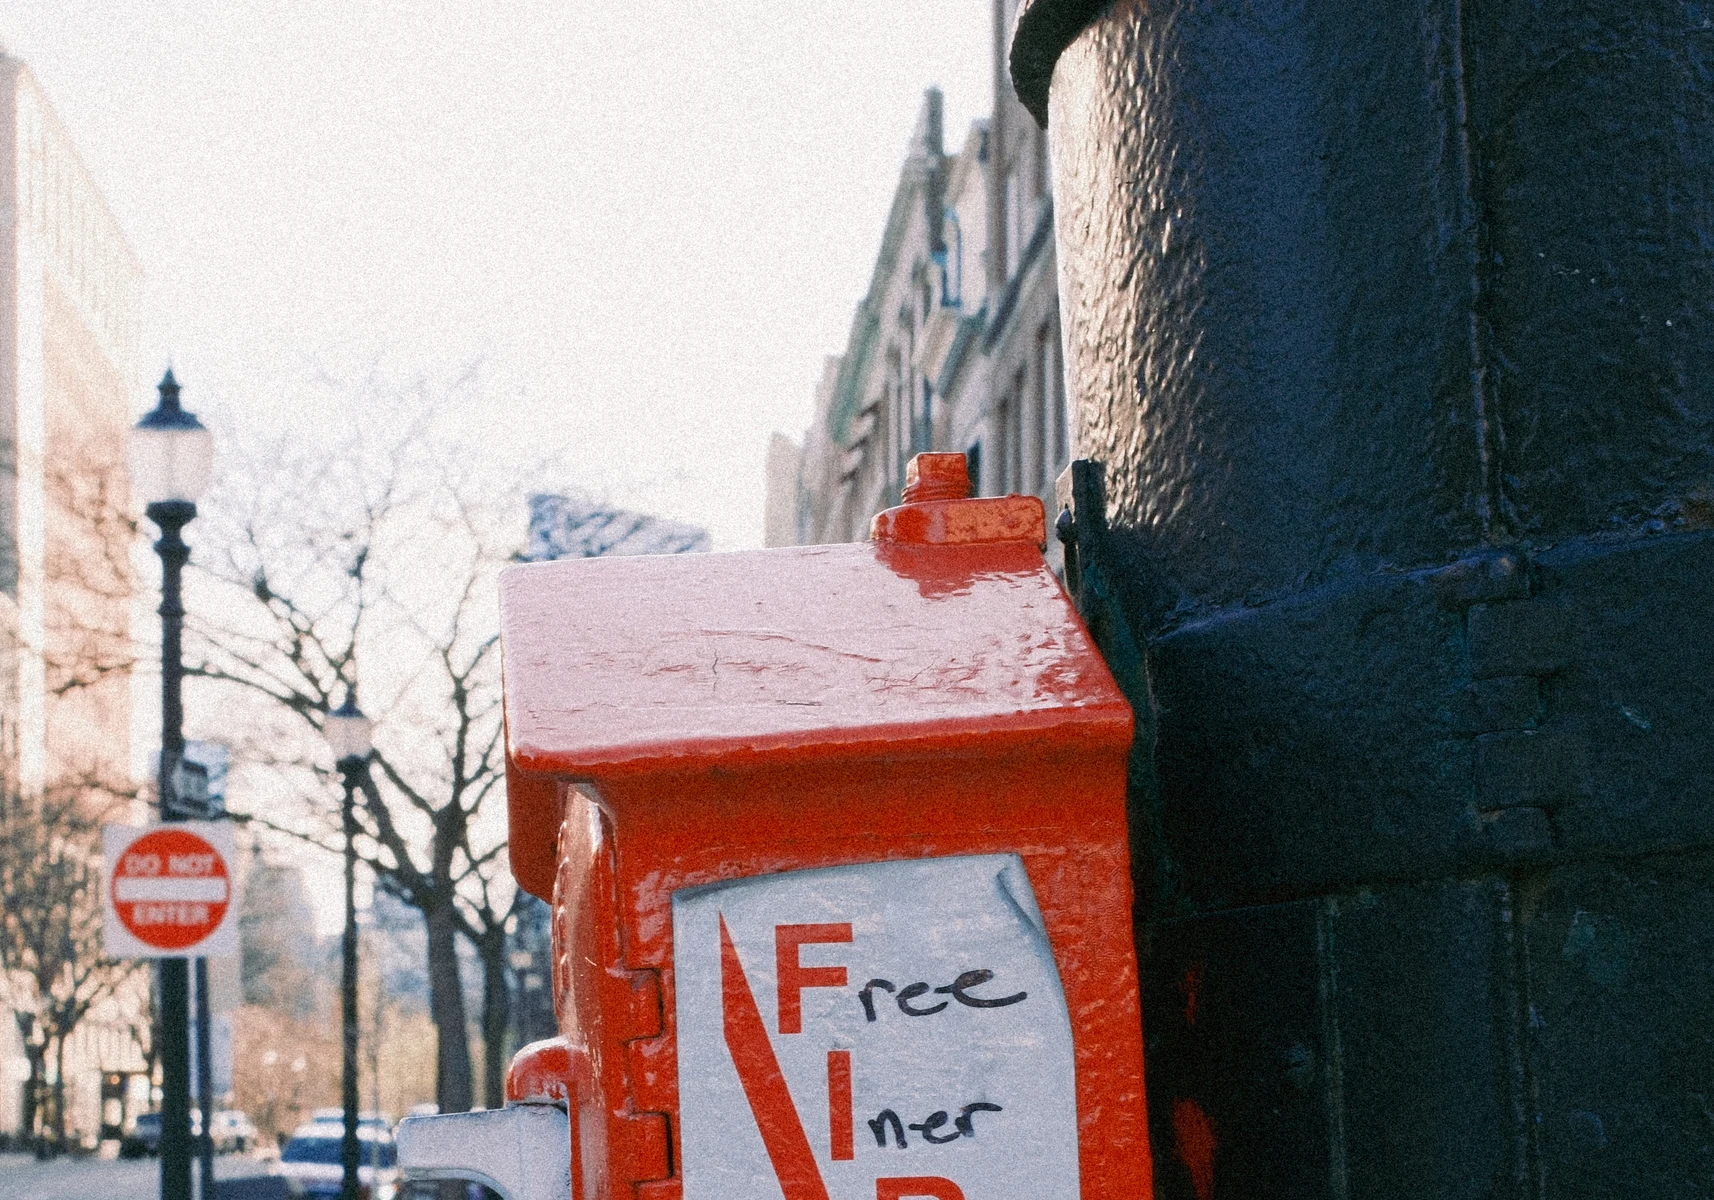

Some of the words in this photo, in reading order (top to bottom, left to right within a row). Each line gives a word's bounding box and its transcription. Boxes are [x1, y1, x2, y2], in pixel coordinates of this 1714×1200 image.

[124, 853, 162, 876] DO
[169, 853, 215, 876] NOT
[133, 902, 209, 925] ENTER
